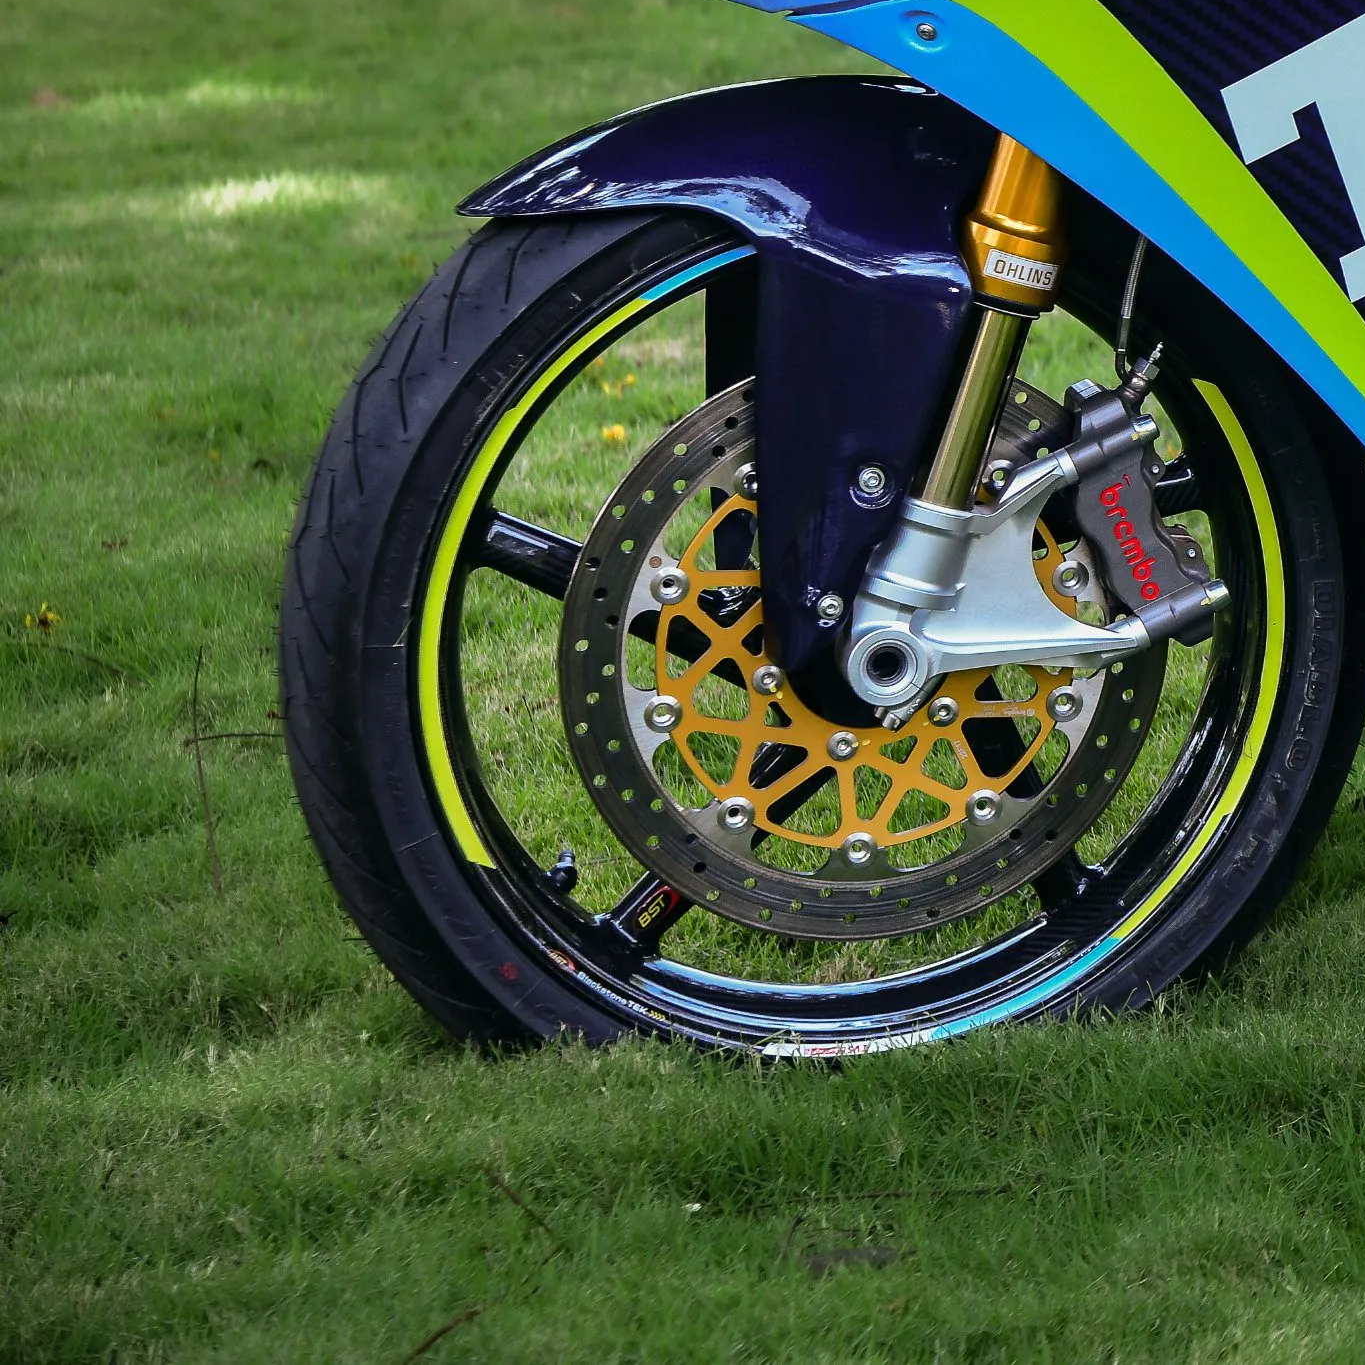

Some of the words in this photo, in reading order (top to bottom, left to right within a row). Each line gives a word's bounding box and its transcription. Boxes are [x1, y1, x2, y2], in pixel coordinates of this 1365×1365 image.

[1099, 481, 1160, 601] brembo
[1285, 579, 1337, 772] DIABLO
[637, 893, 667, 929] BST
